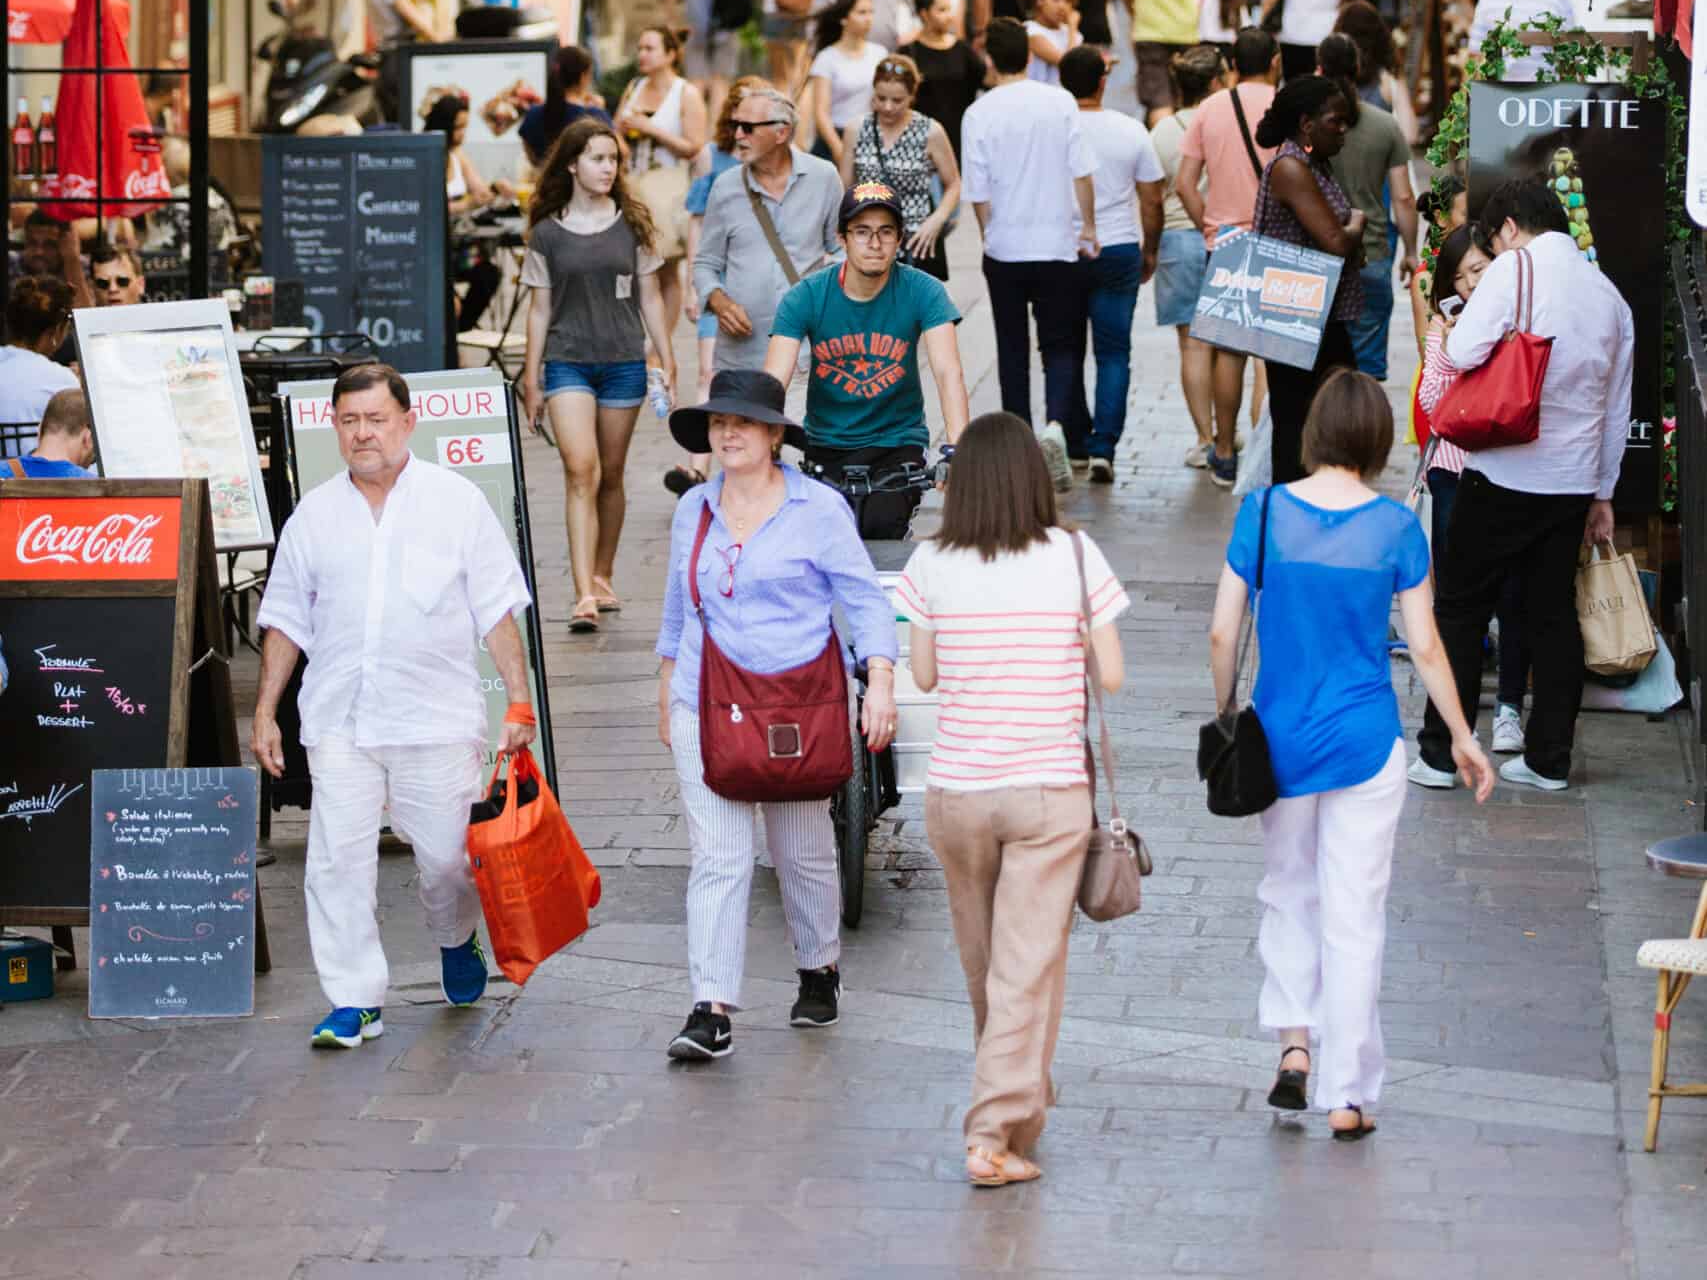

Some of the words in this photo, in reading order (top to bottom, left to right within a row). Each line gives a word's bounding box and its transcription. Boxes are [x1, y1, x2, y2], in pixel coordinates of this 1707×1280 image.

[1498, 97, 1640, 129] ODETTE
[815, 332, 867, 361] WORK
[870, 332, 910, 362] NOW
[446, 437, 485, 465] 6€
[16, 514, 163, 564] Coca-Cola
